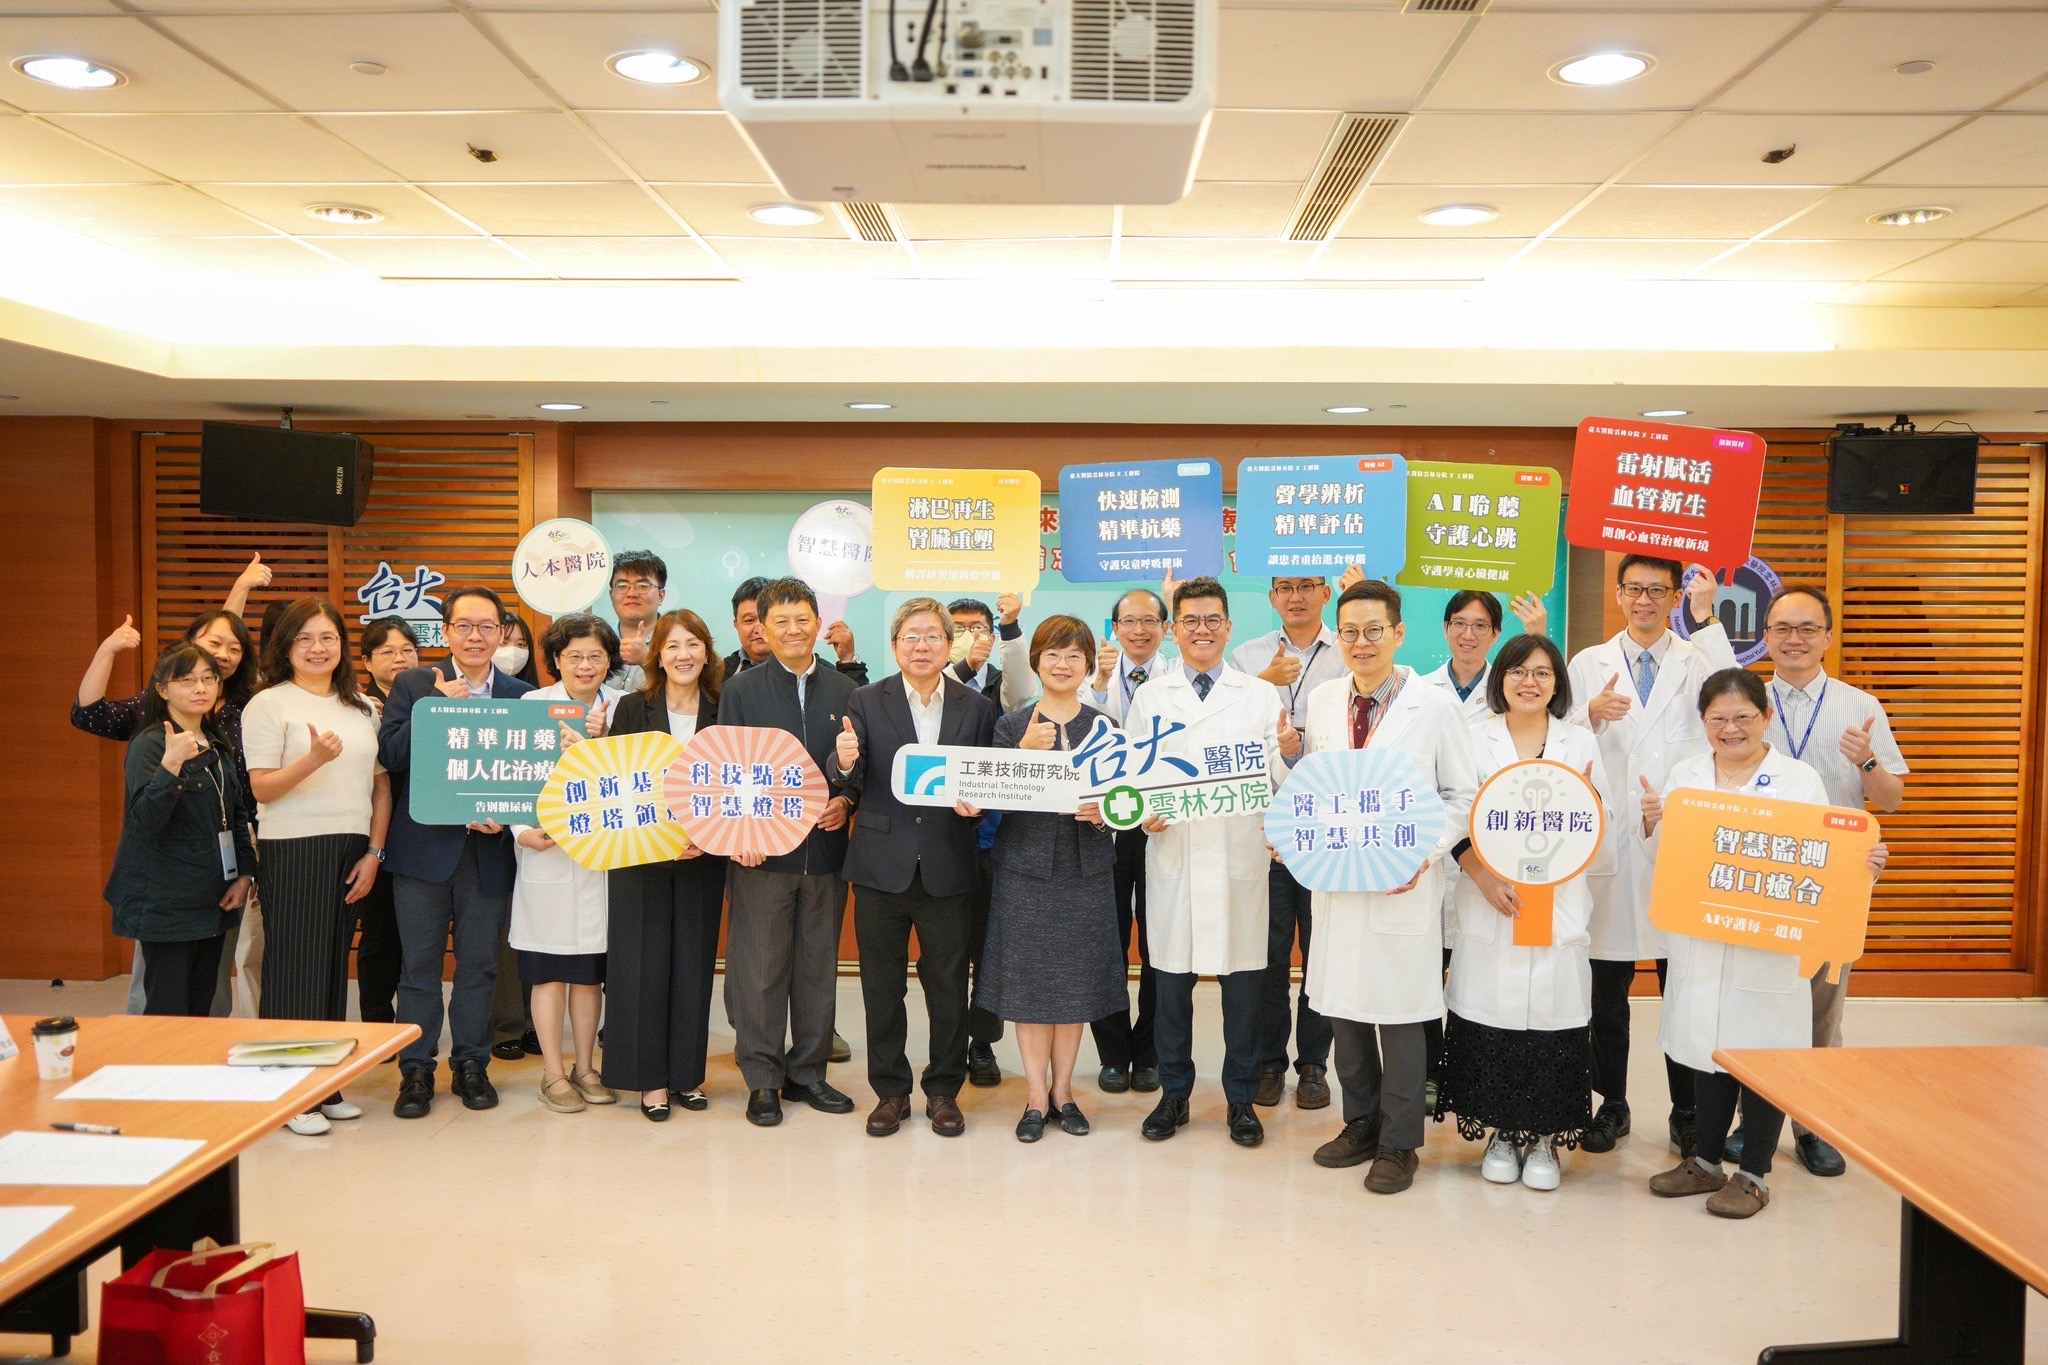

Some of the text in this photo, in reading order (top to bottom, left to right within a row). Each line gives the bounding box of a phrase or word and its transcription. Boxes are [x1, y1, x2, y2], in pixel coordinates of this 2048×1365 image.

[1588, 426, 1640, 438] 臺大醫院雲林分院
[1070, 470, 1115, 478] 臺大醫院雲林分院
[1616, 452, 1712, 484] 雷射賦活
[1098, 488, 1180, 512] 快速檢測
[1276, 482, 1365, 505] 聲學辨析
[1611, 485, 1707, 518] 血管新生
[908, 497, 994, 520] 淋巴再生
[1098, 518, 1181, 540] 精準抗藥
[1274, 514, 1364, 535] 精準評估
[1425, 523, 1518, 549] 守護心跳
[908, 527, 994, 551] 腎臟重塑
[1602, 526, 1710, 552] 開創心血管治療新境
[520, 551, 606, 581] 人本醫院
[1099, 558, 1182, 570] 守護兒童呼吸健康
[1268, 554, 1366, 566] 讓患者重拾進食尊嚴
[1420, 564, 1510, 580] 守護學童心臟健康
[1746, 560, 1777, 589] 醫院雲林
[362, 567, 442, 613] 台大
[446, 727, 556, 750] 精準用藥
[1072, 714, 1266, 787] 台大 醫院
[446, 759, 556, 781] 個人化治療
[690, 762, 802, 787] 科技點亮
[960, 760, 1080, 781] 工業技術研究院
[566, 770, 667, 803] 創新基
[958, 790, 1032, 800] Research Institute
[959, 780, 1046, 792] Industrial Technology
[475, 801, 532, 813] 告別糖尿病
[691, 794, 802, 818] 智慧燈塔
[1148, 780, 1270, 820] 雲林分院
[1293, 787, 1415, 817] 醫工攜手
[570, 802, 677, 836] 燈塔領
[1486, 809, 1593, 833] 創新醫院
[1294, 824, 1417, 852] 智慧共創
[1713, 825, 1830, 868] 智慧監測
[1708, 862, 1824, 906] 傷口癒合
[1702, 912, 1804, 941] AI守護每一道傷
